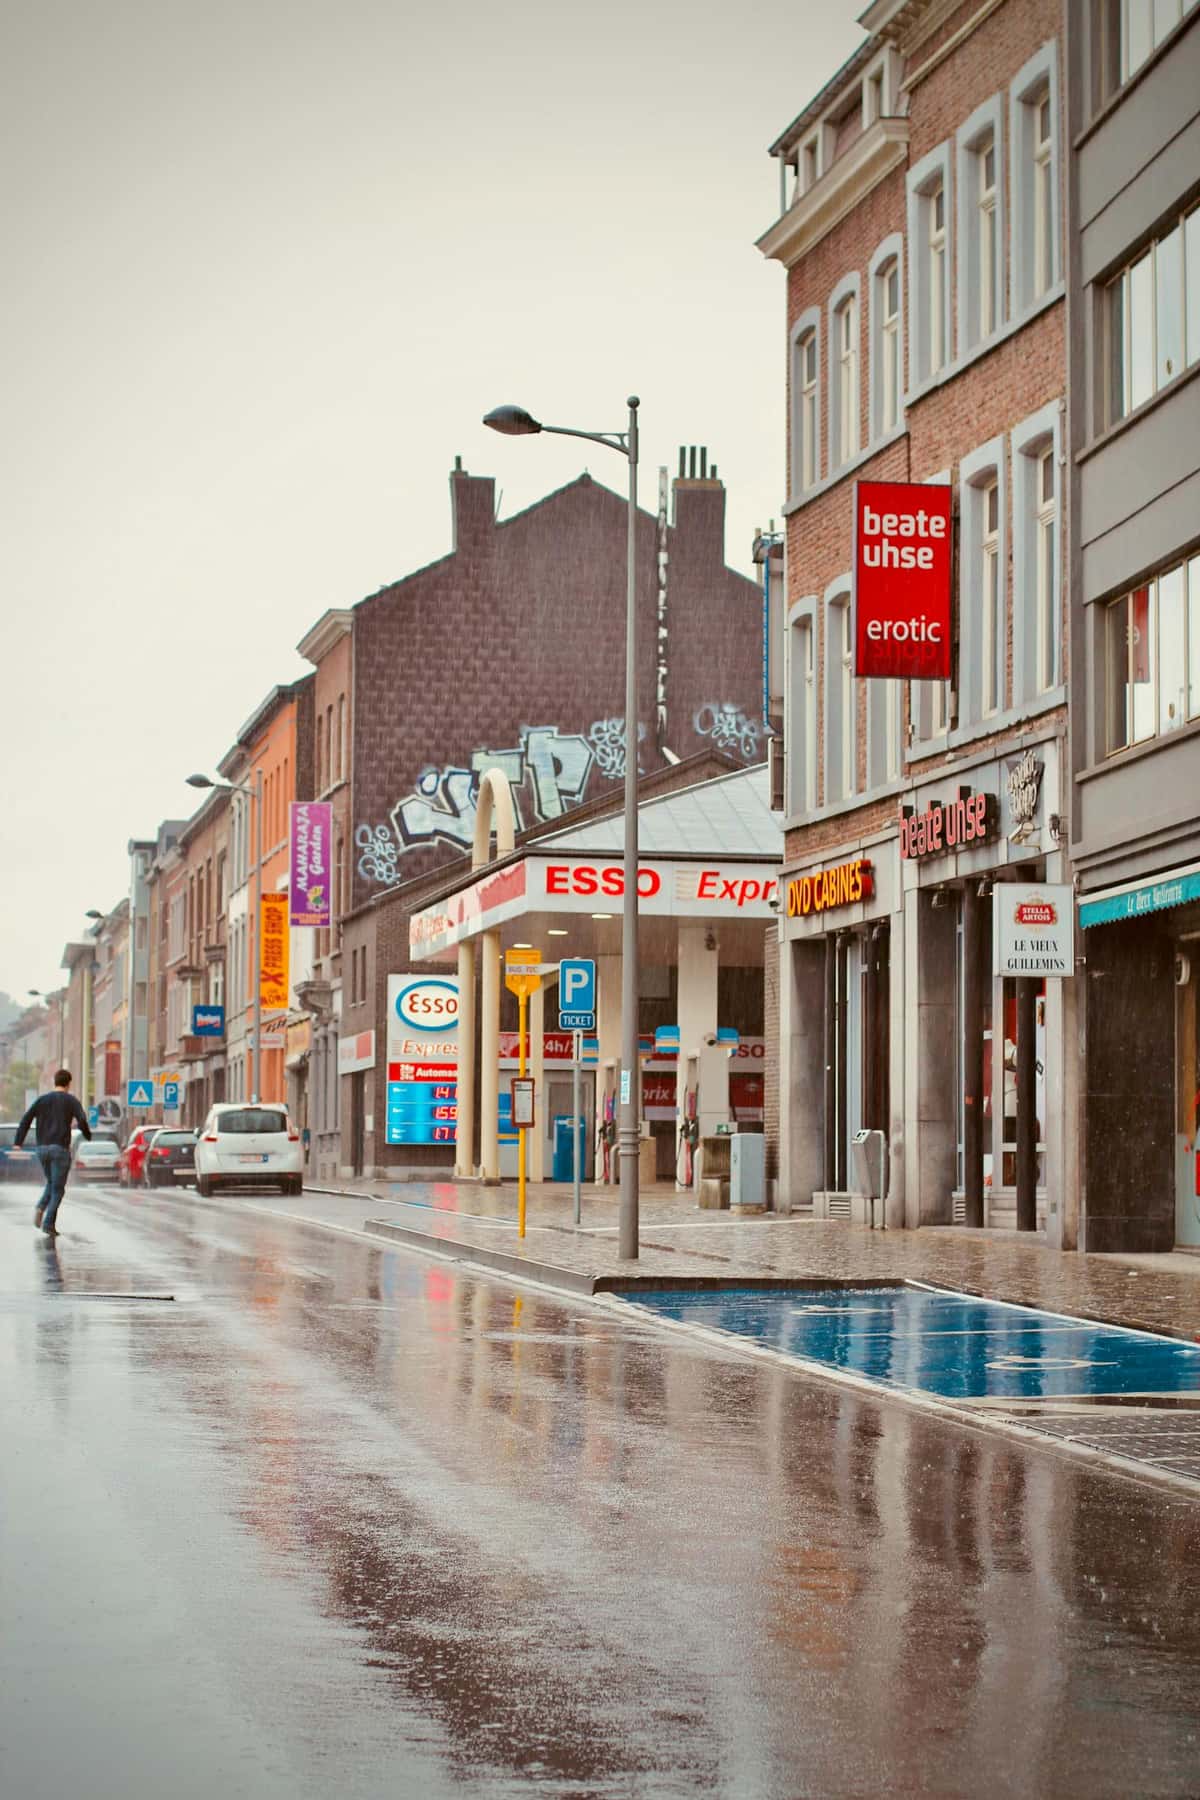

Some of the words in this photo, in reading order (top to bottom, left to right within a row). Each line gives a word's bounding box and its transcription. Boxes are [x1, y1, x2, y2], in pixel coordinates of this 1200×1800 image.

[863, 505, 946, 538] beate
[863, 538, 934, 569] uhse
[866, 614, 941, 643] erotic
[899, 801, 943, 860] beate
[296, 805, 311, 893] MAHARAJA
[309, 825, 325, 875] Garden
[545, 865, 661, 897] ESSO
[697, 871, 780, 907] Expr
[787, 876, 812, 918] DVD
[813, 860, 863, 911] CABINES
[264, 907, 283, 934] SHOP
[1022, 906, 1050, 914] STELLA
[1014, 940, 1026, 952] LE
[1030, 940, 1058, 952] VIEUX
[1007, 958, 1065, 970] GUILLEMINS
[565, 967, 589, 1004] P
[408, 993, 458, 1014] Esso
[563, 1015, 592, 1026] TICKET
[166, 1085, 177, 1100] P
